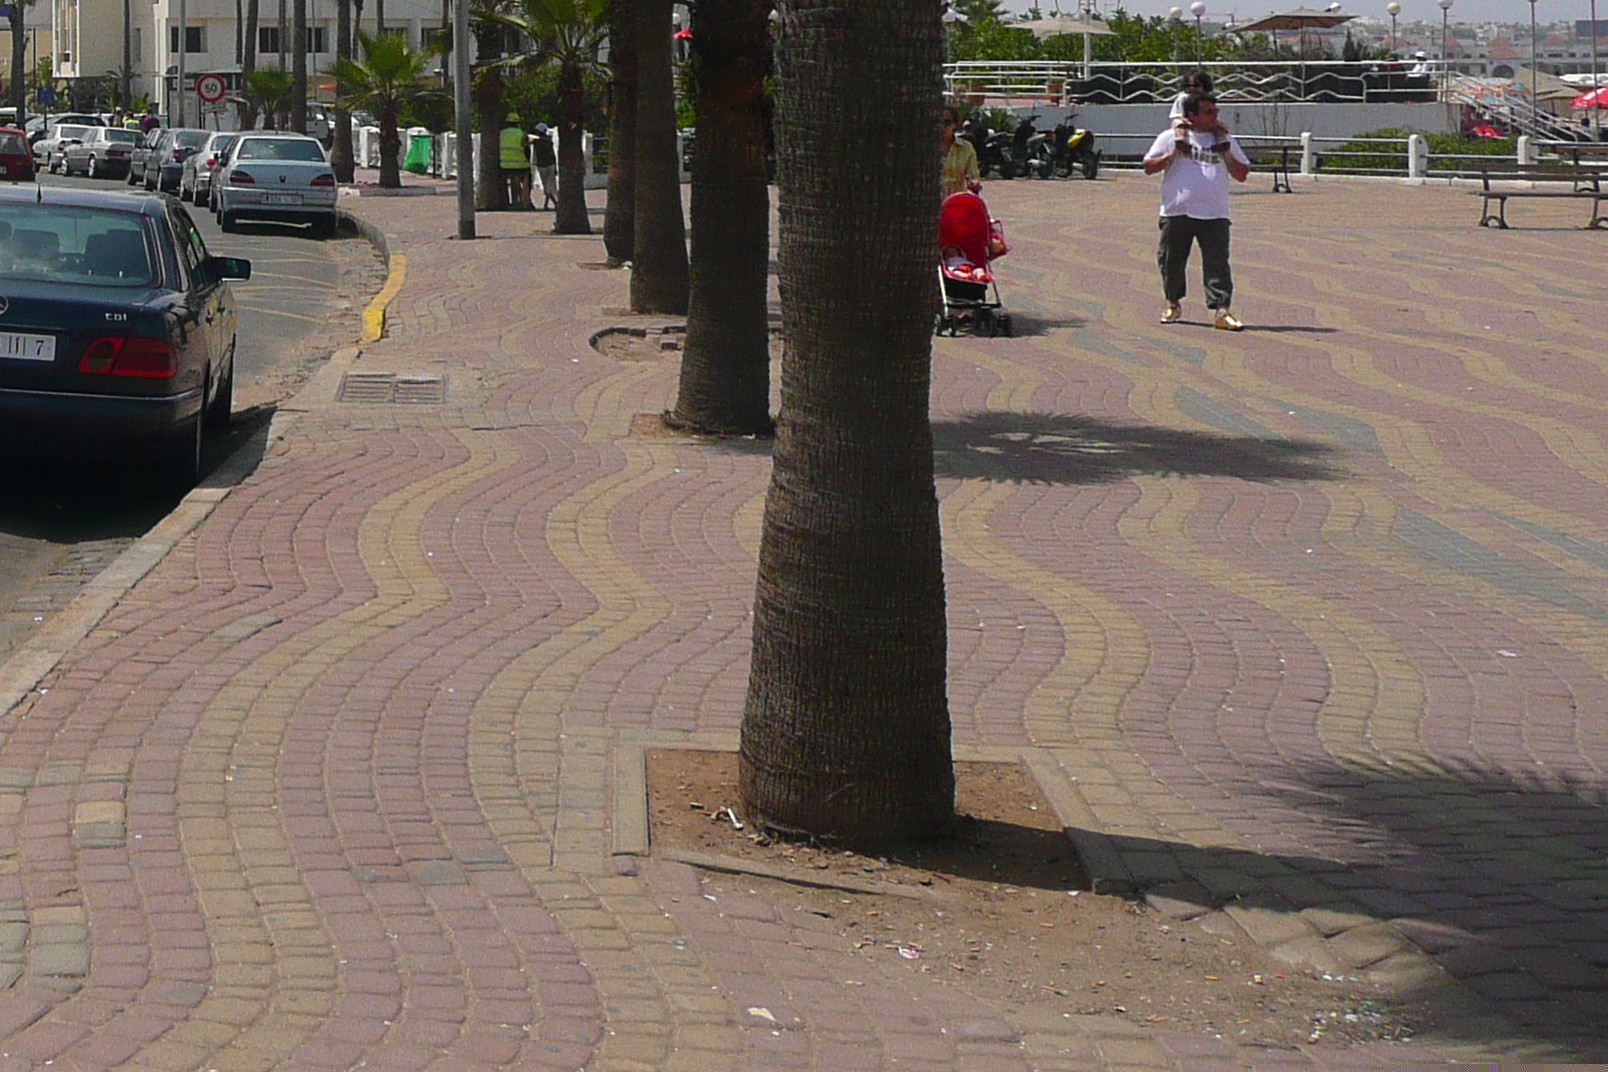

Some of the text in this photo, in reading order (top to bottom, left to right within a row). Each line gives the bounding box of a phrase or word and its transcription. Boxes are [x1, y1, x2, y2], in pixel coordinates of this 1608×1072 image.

[204, 83, 218, 94] 50
[105, 312, 127, 321] CDI
[35, 339, 45, 357] 7
